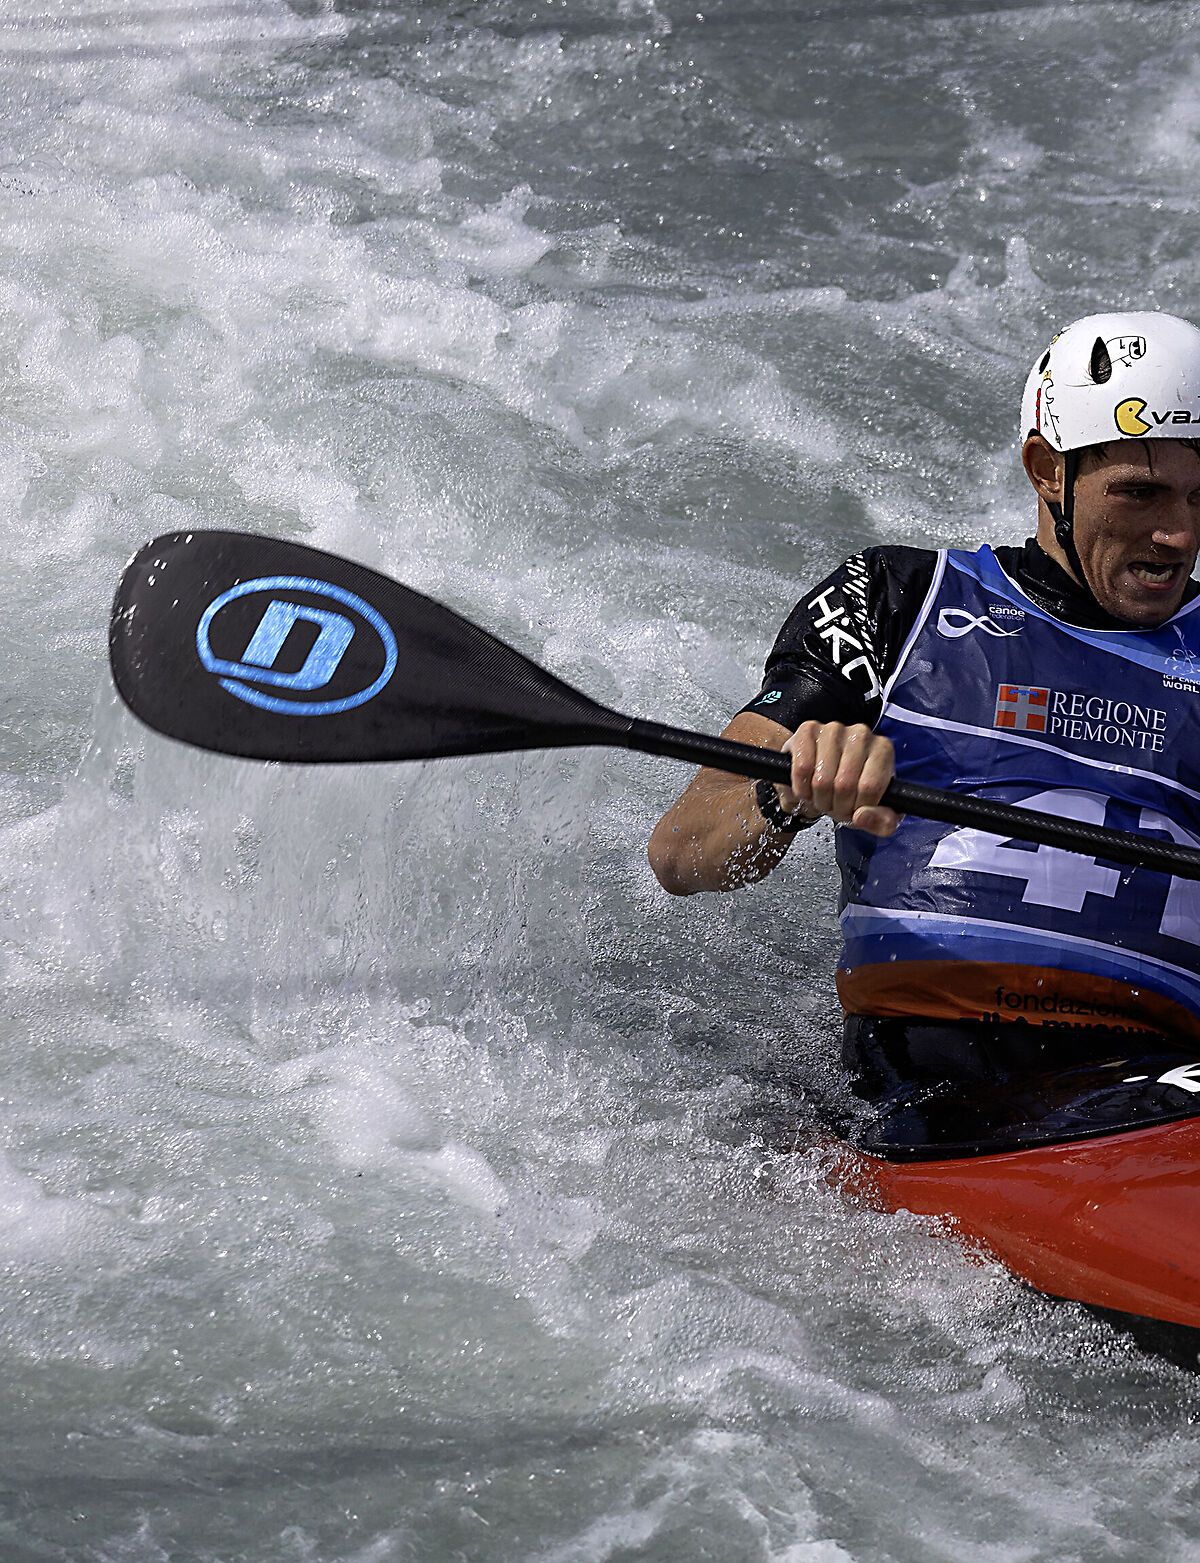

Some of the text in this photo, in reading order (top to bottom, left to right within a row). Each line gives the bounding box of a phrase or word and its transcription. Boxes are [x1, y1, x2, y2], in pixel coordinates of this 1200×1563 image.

[988, 605, 1026, 618] canoe
[1051, 690, 1168, 732] REGIONE
[1049, 715, 1166, 753] PIEMONTE
[994, 986, 1145, 1020] fondazione
